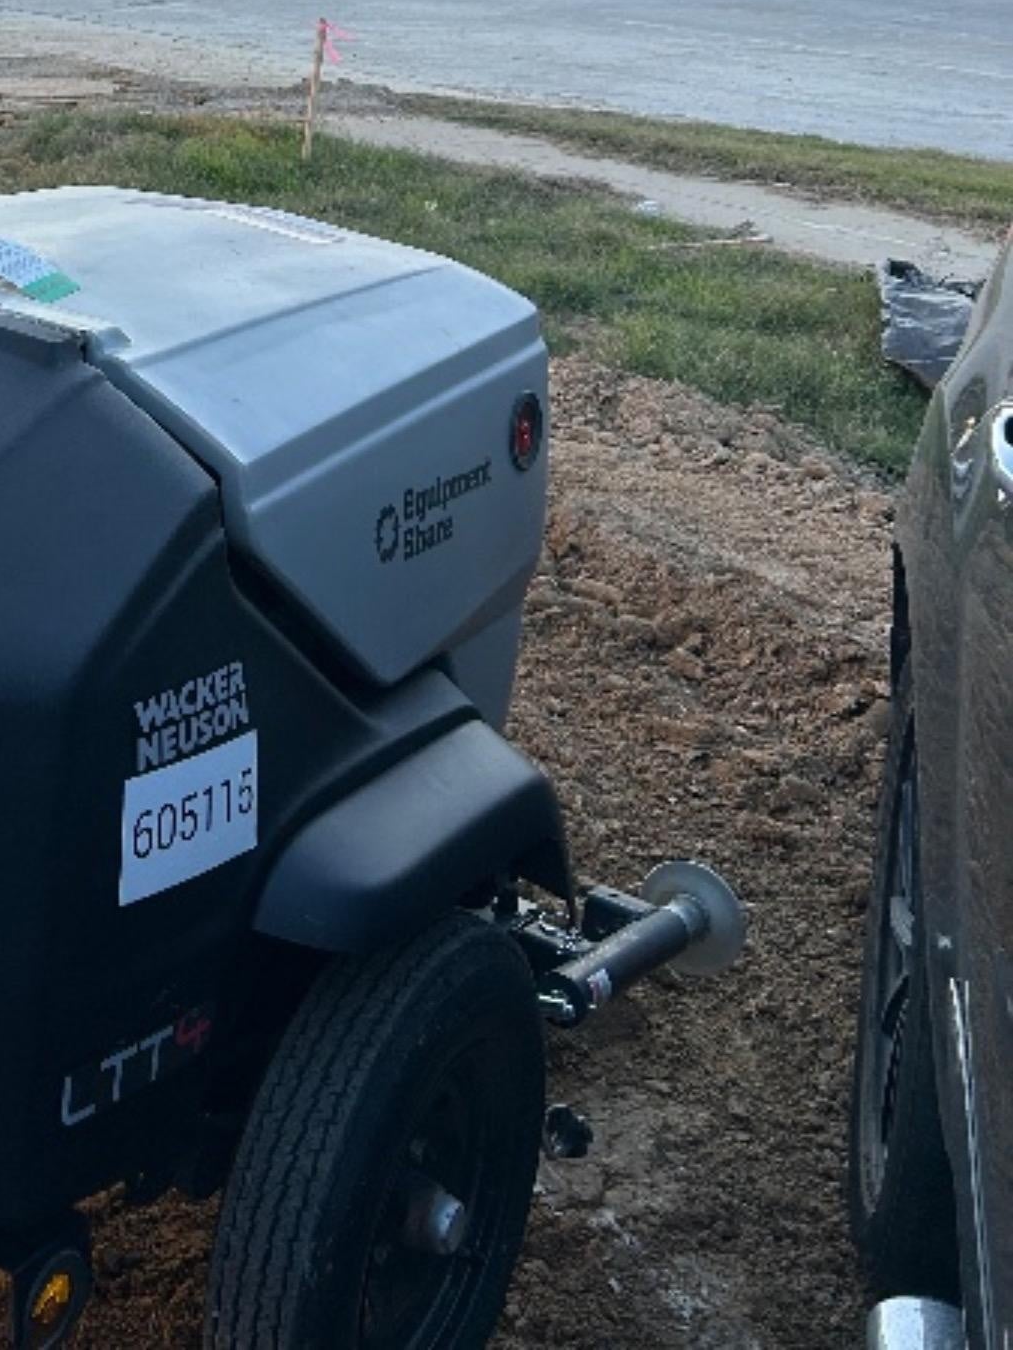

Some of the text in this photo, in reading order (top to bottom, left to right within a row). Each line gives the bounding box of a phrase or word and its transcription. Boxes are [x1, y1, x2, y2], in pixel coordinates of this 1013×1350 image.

[403, 456, 491, 522] Equipment
[403, 516, 453, 562] Share
[134, 660, 246, 734] WACKER
[136, 693, 250, 771] NEUSON
[133, 767, 253, 859] 605115
